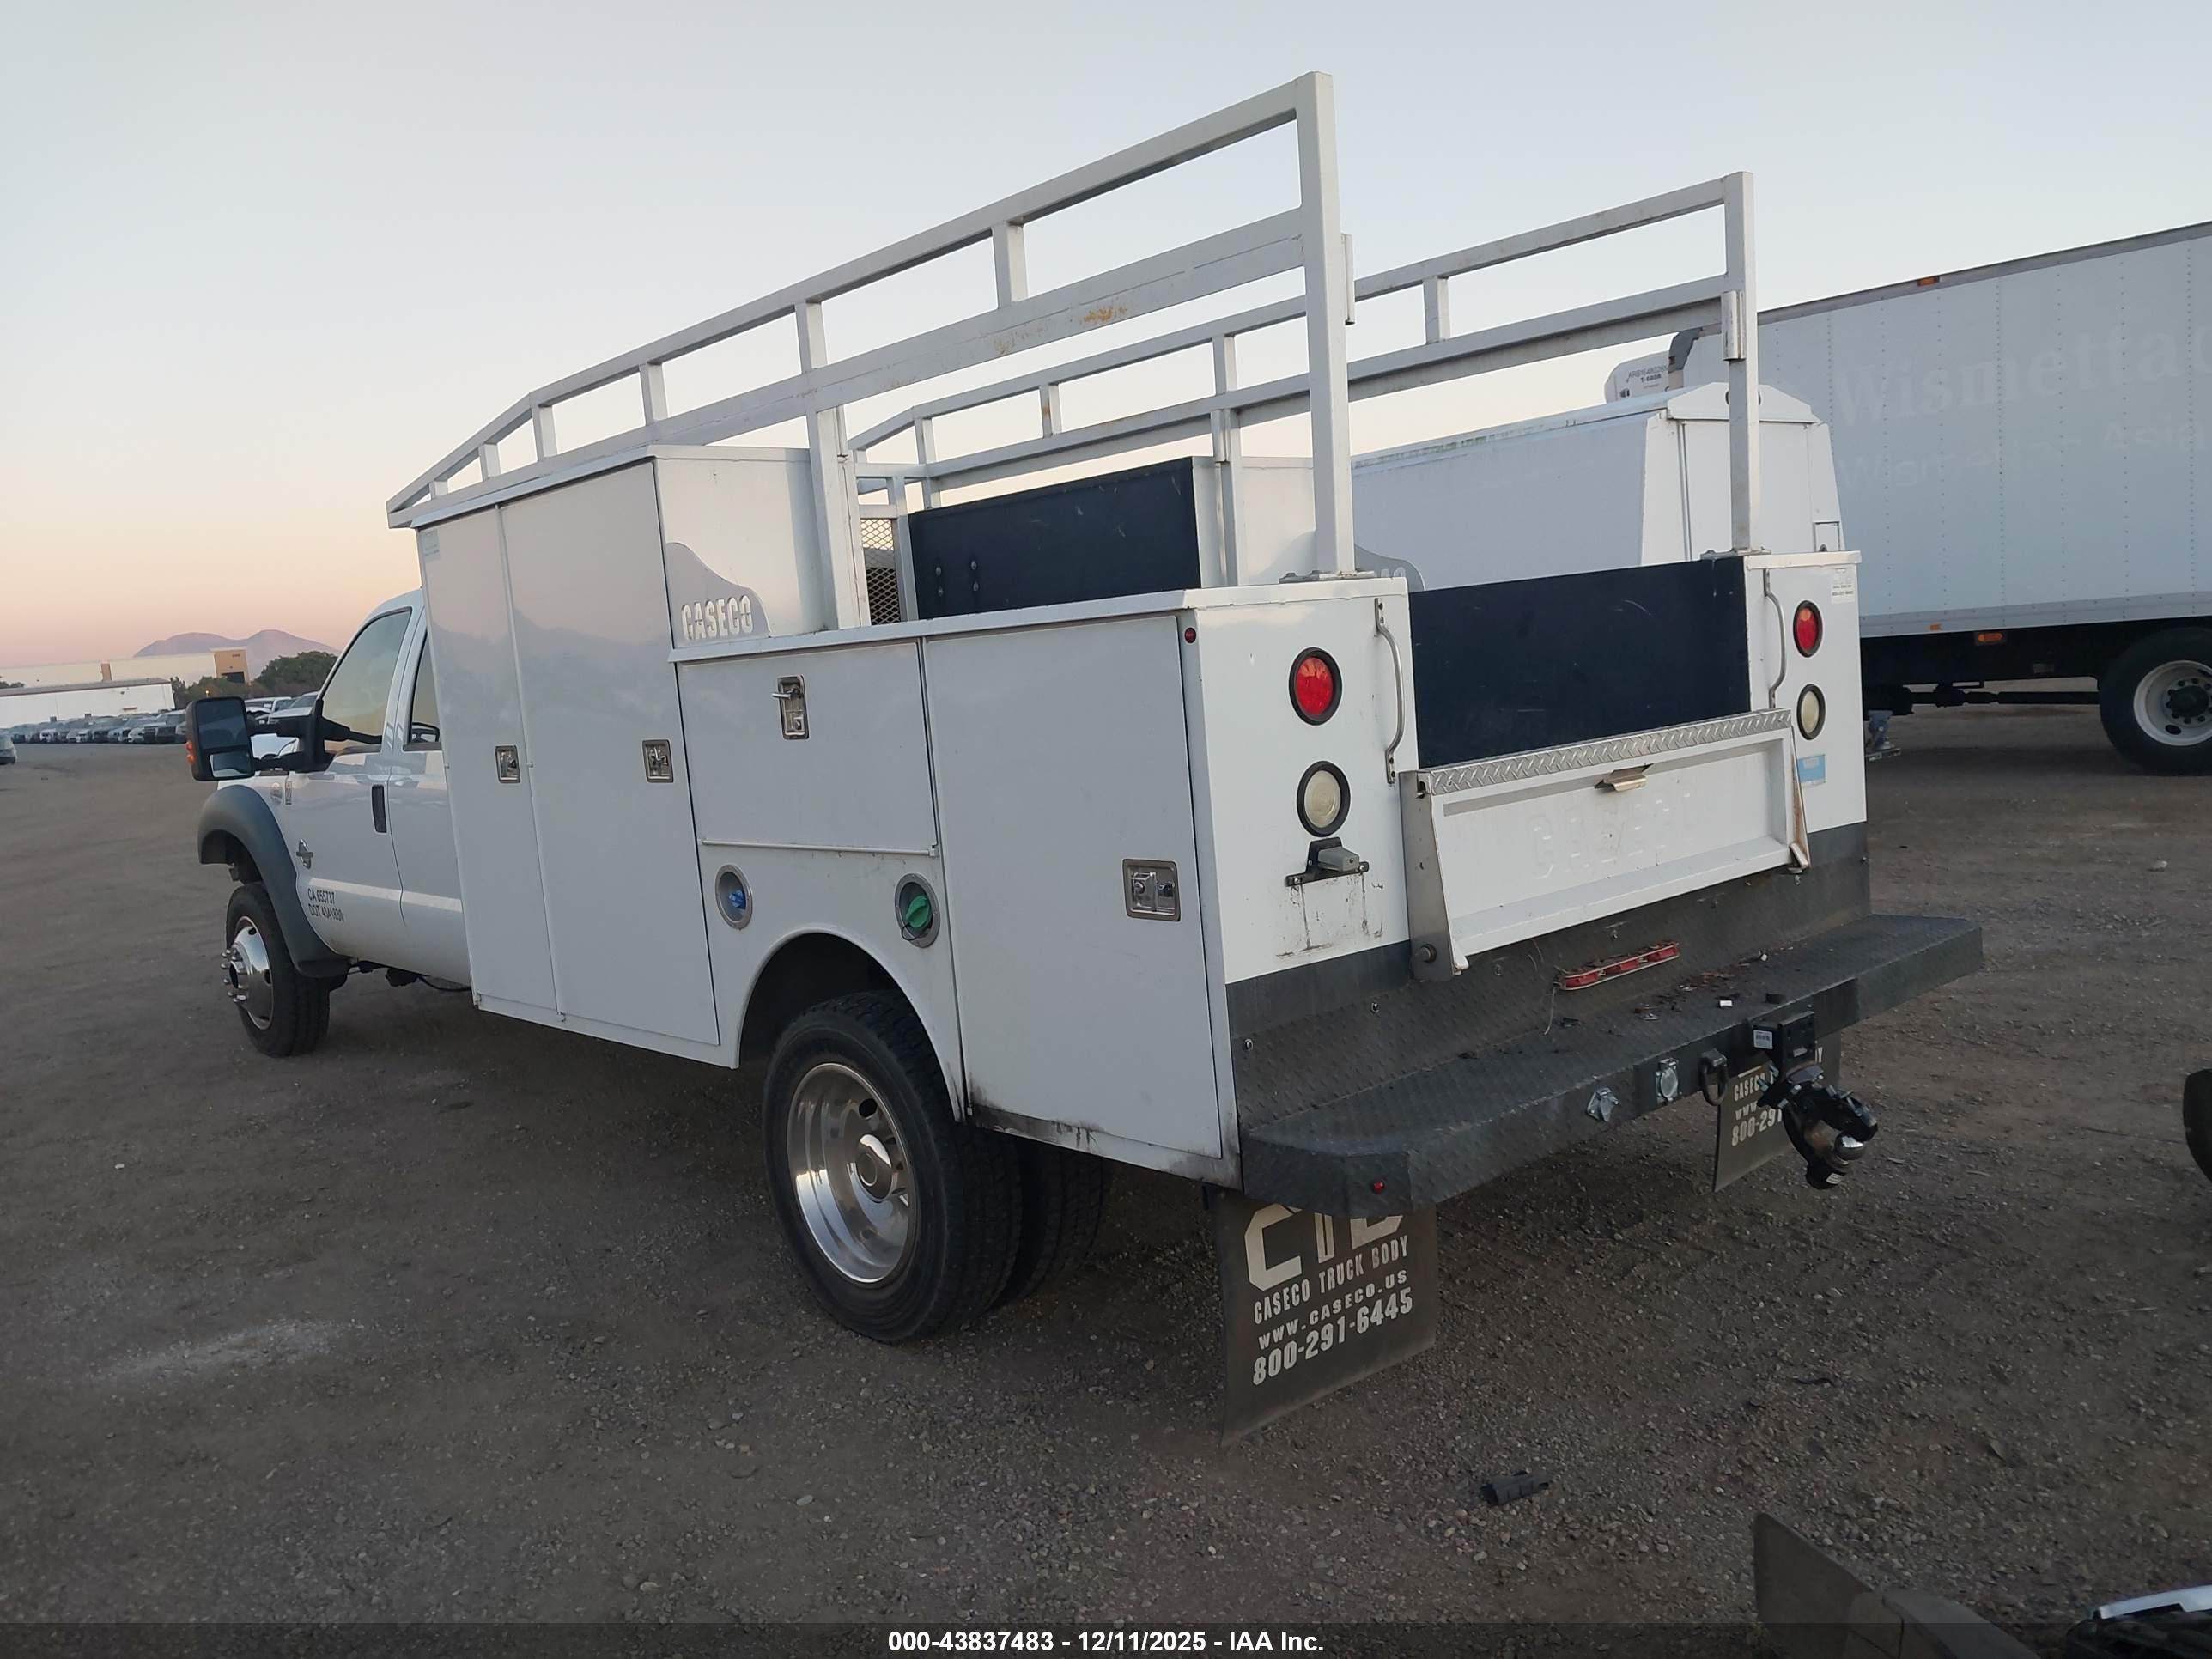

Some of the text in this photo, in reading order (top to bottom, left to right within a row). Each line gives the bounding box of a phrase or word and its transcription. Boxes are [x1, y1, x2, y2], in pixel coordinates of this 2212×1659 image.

[682, 595, 753, 640] CASECO
[307, 888, 317, 902] CA
[308, 903, 321, 918] DOT
[1254, 1279, 1310, 1325] CASECO
[1318, 1253, 1364, 1293] TRUCK
[1371, 1235, 1408, 1270] BODY
[1253, 1286, 1413, 1386] 800-291-6445
